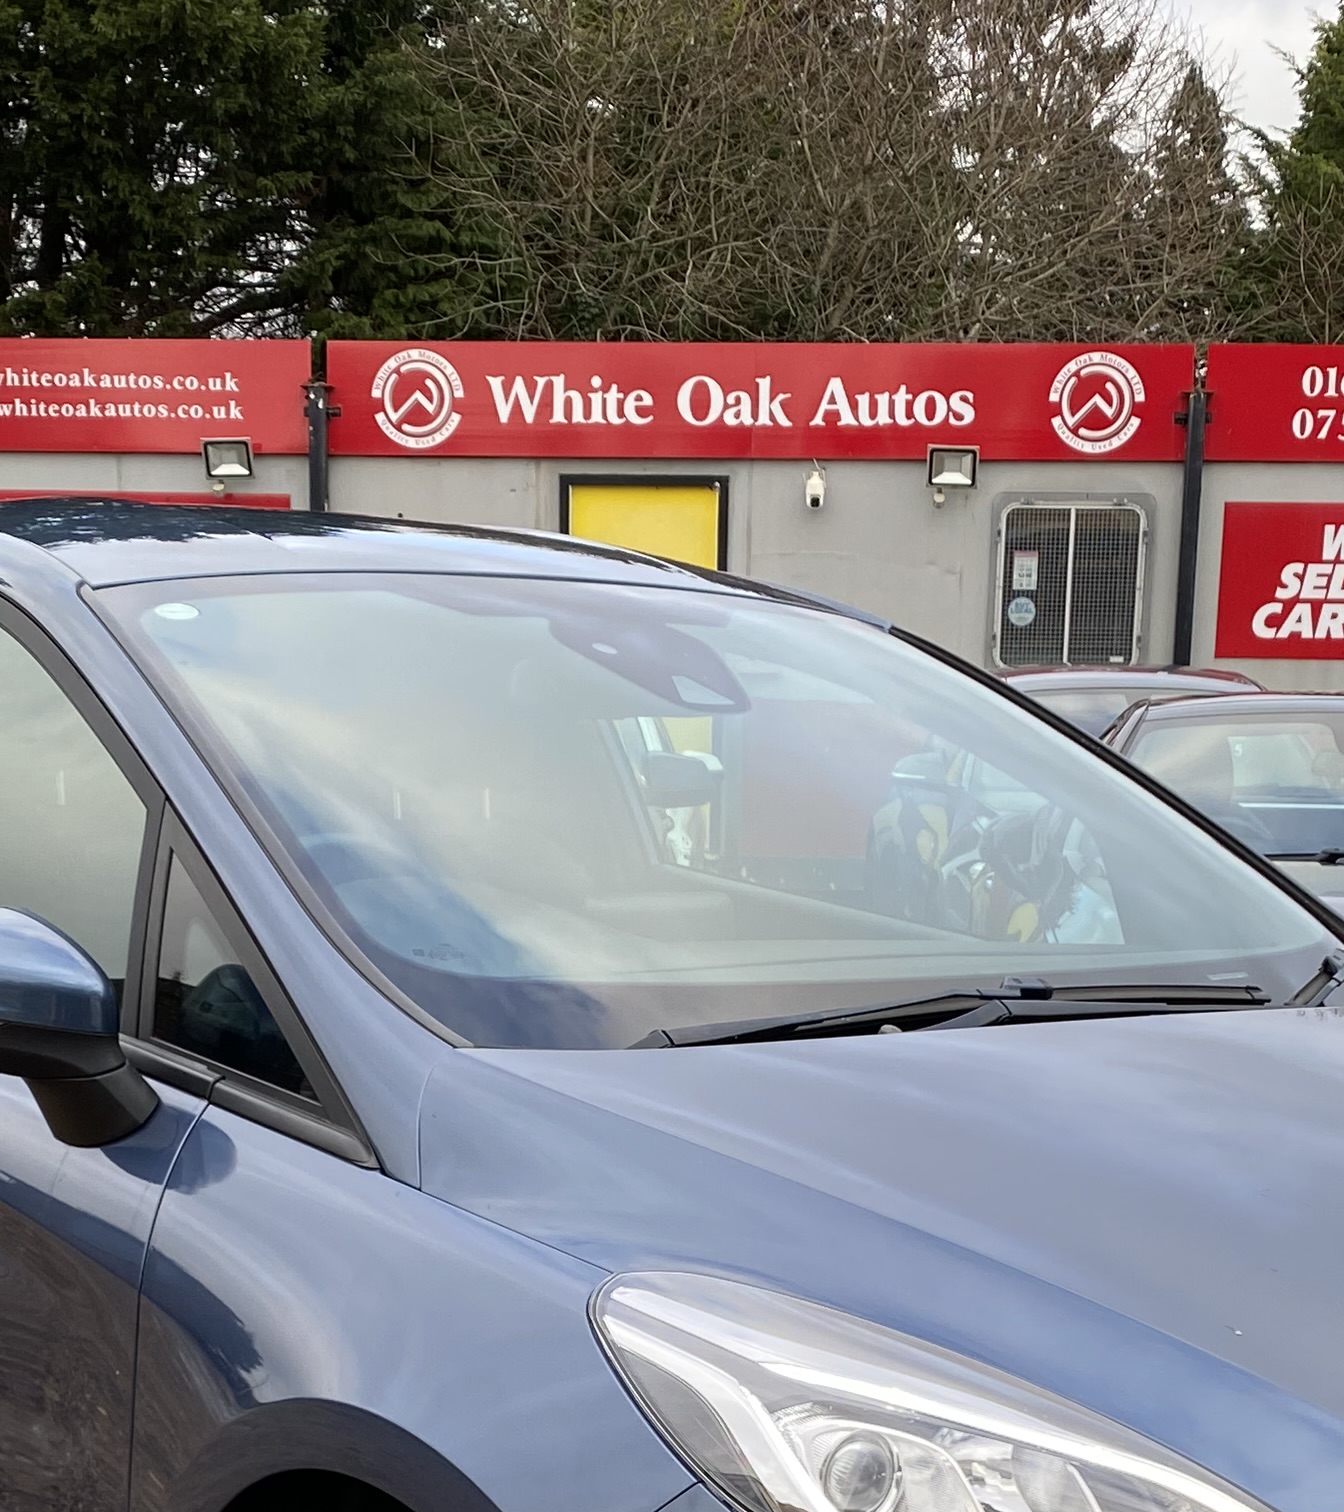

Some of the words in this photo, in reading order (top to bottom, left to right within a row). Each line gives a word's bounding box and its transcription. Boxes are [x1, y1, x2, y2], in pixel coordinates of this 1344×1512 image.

[394, 351, 413, 365] Oak
[1075, 354, 1094, 367] Oak
[1100, 353, 1130, 374] Motors
[486, 373, 655, 427] White
[676, 374, 794, 428] Oak
[809, 376, 976, 428] Autos
[1091, 440, 1113, 451] Used
